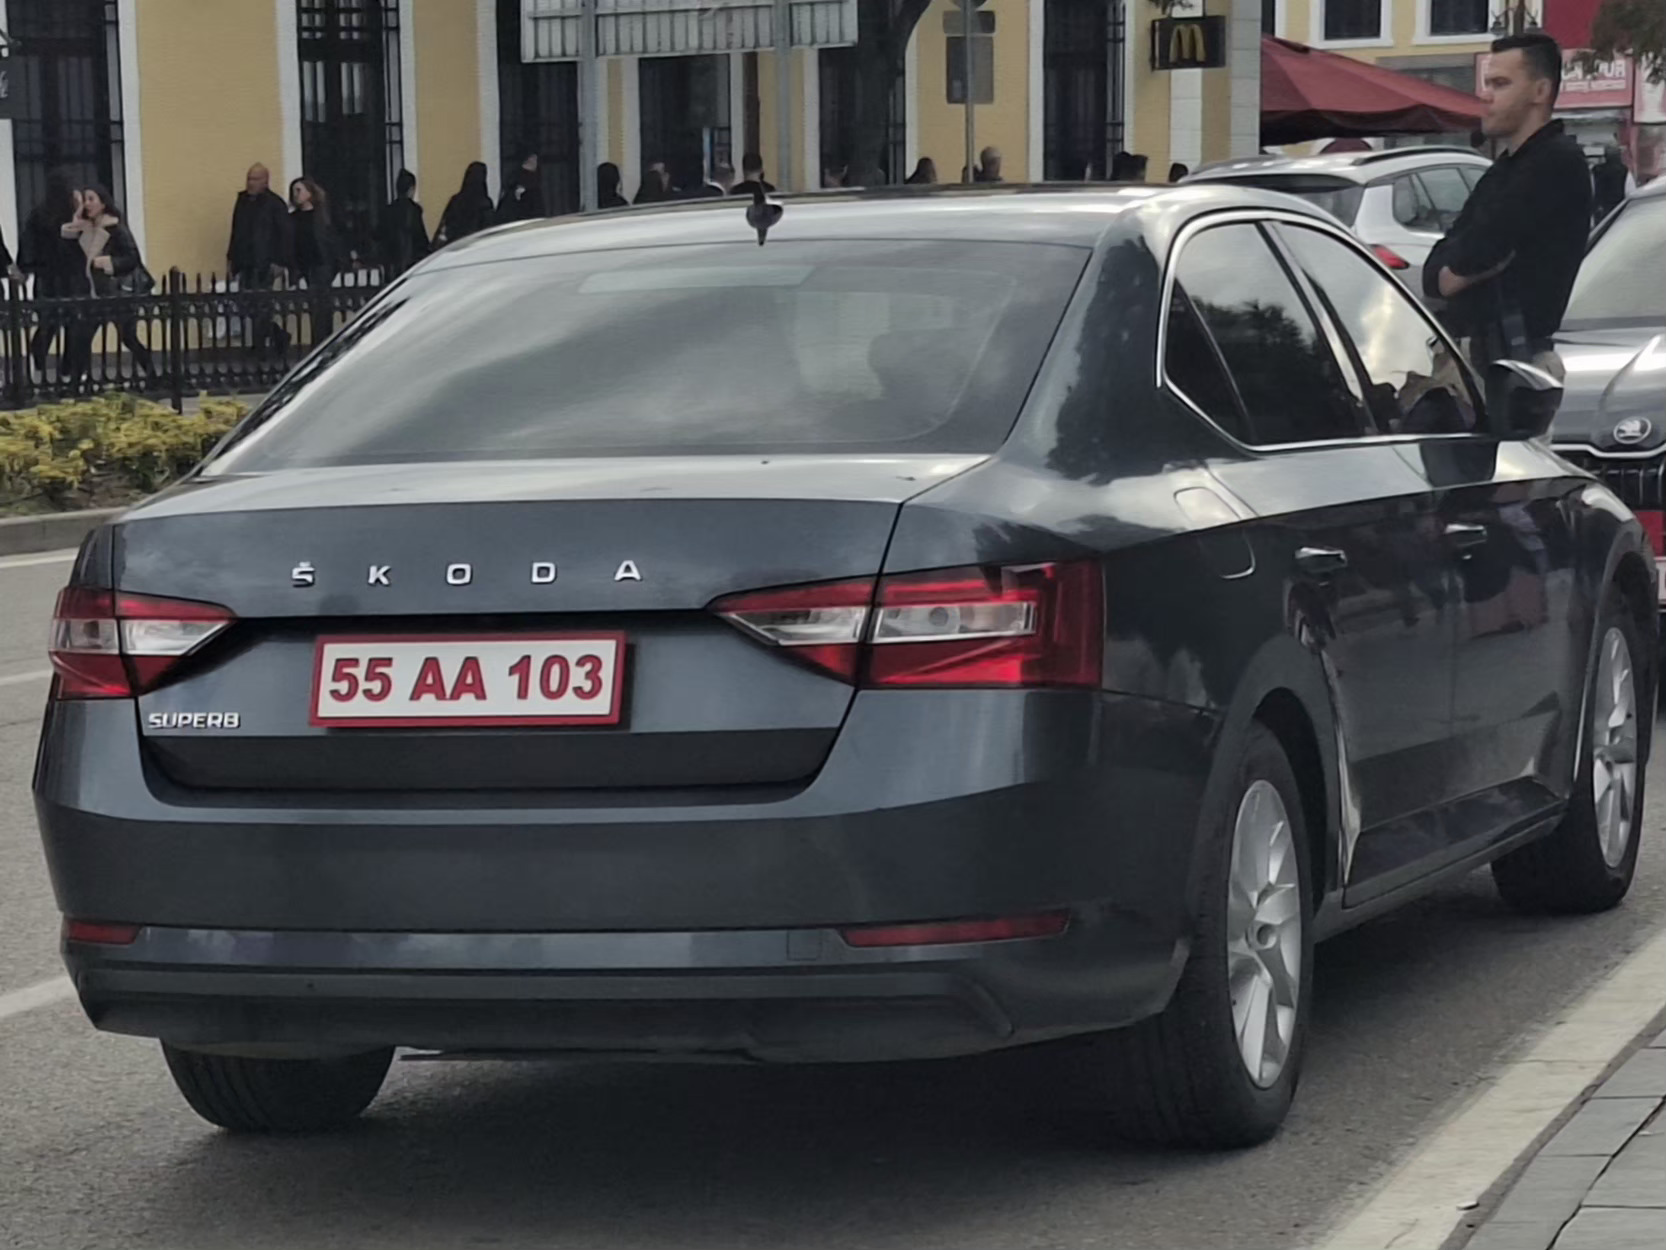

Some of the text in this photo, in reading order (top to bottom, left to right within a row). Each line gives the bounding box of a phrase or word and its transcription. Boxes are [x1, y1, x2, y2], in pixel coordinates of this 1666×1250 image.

[329, 654, 603, 702] 55 AA 103
[148, 711, 240, 730] SUPERB
